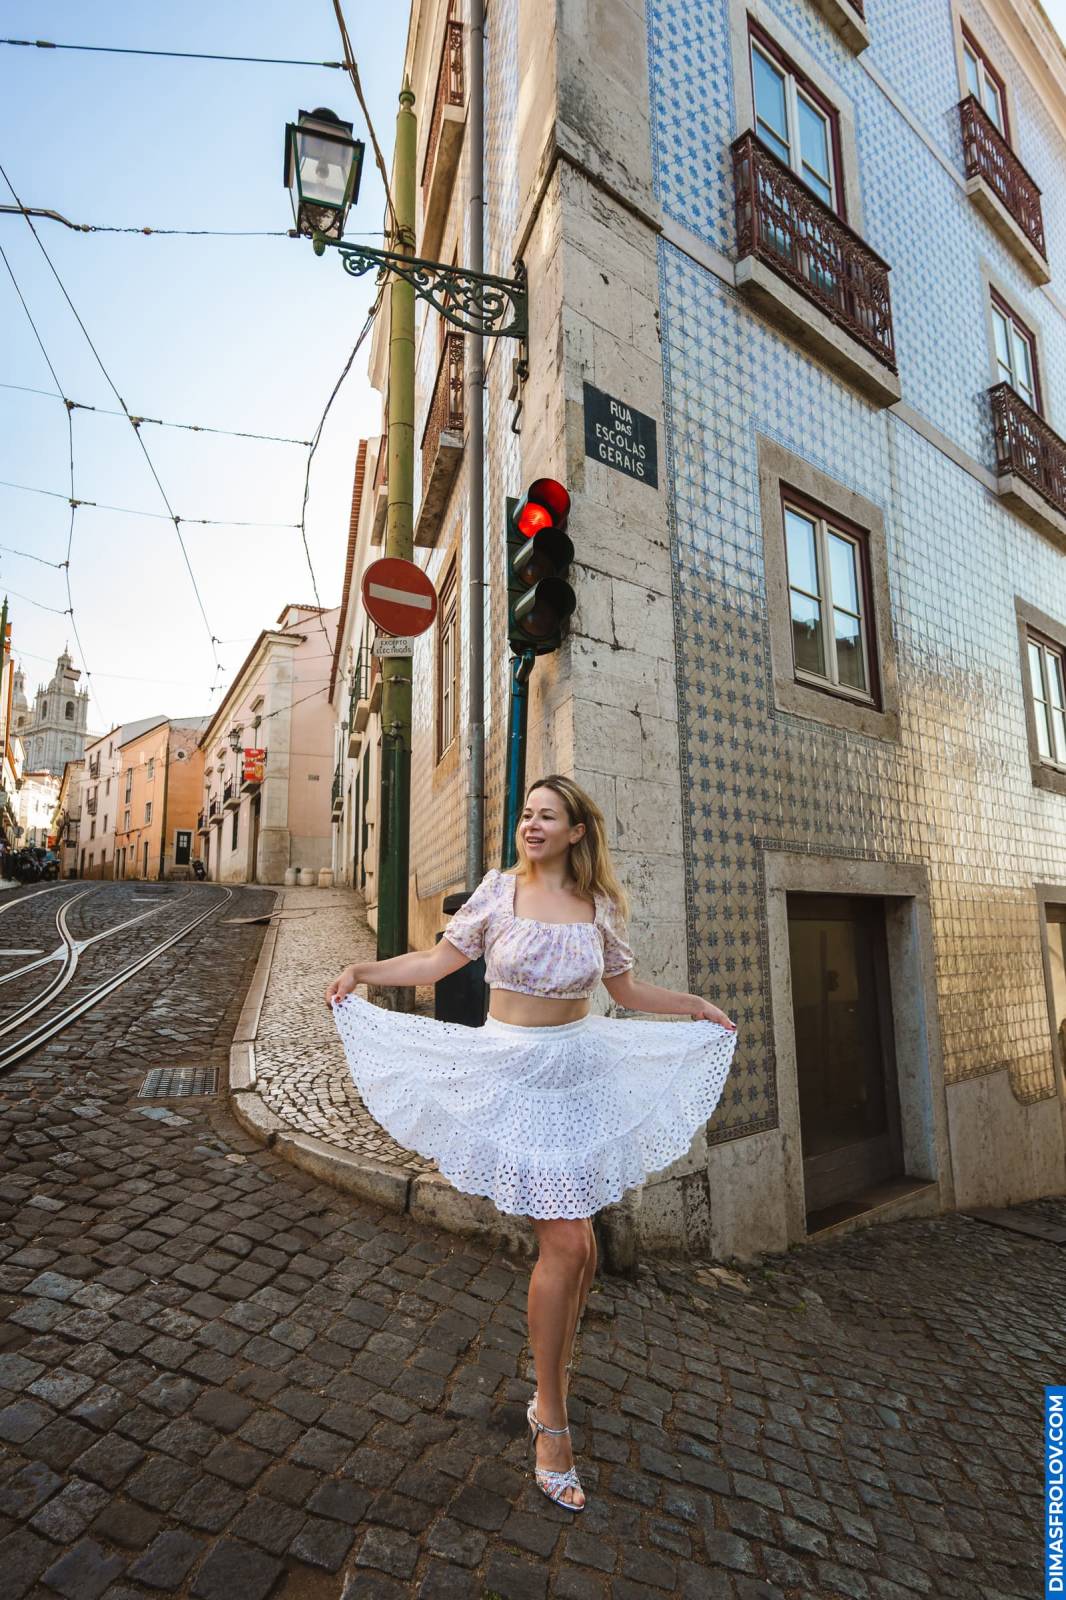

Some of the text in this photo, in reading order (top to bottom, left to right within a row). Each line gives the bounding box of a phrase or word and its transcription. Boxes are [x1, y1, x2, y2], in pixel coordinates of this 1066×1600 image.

[610, 401, 632, 424] RUA
[595, 423, 646, 459] ESCOLAS
[615, 420, 632, 436] DAS
[599, 443, 644, 476] GERAIS
